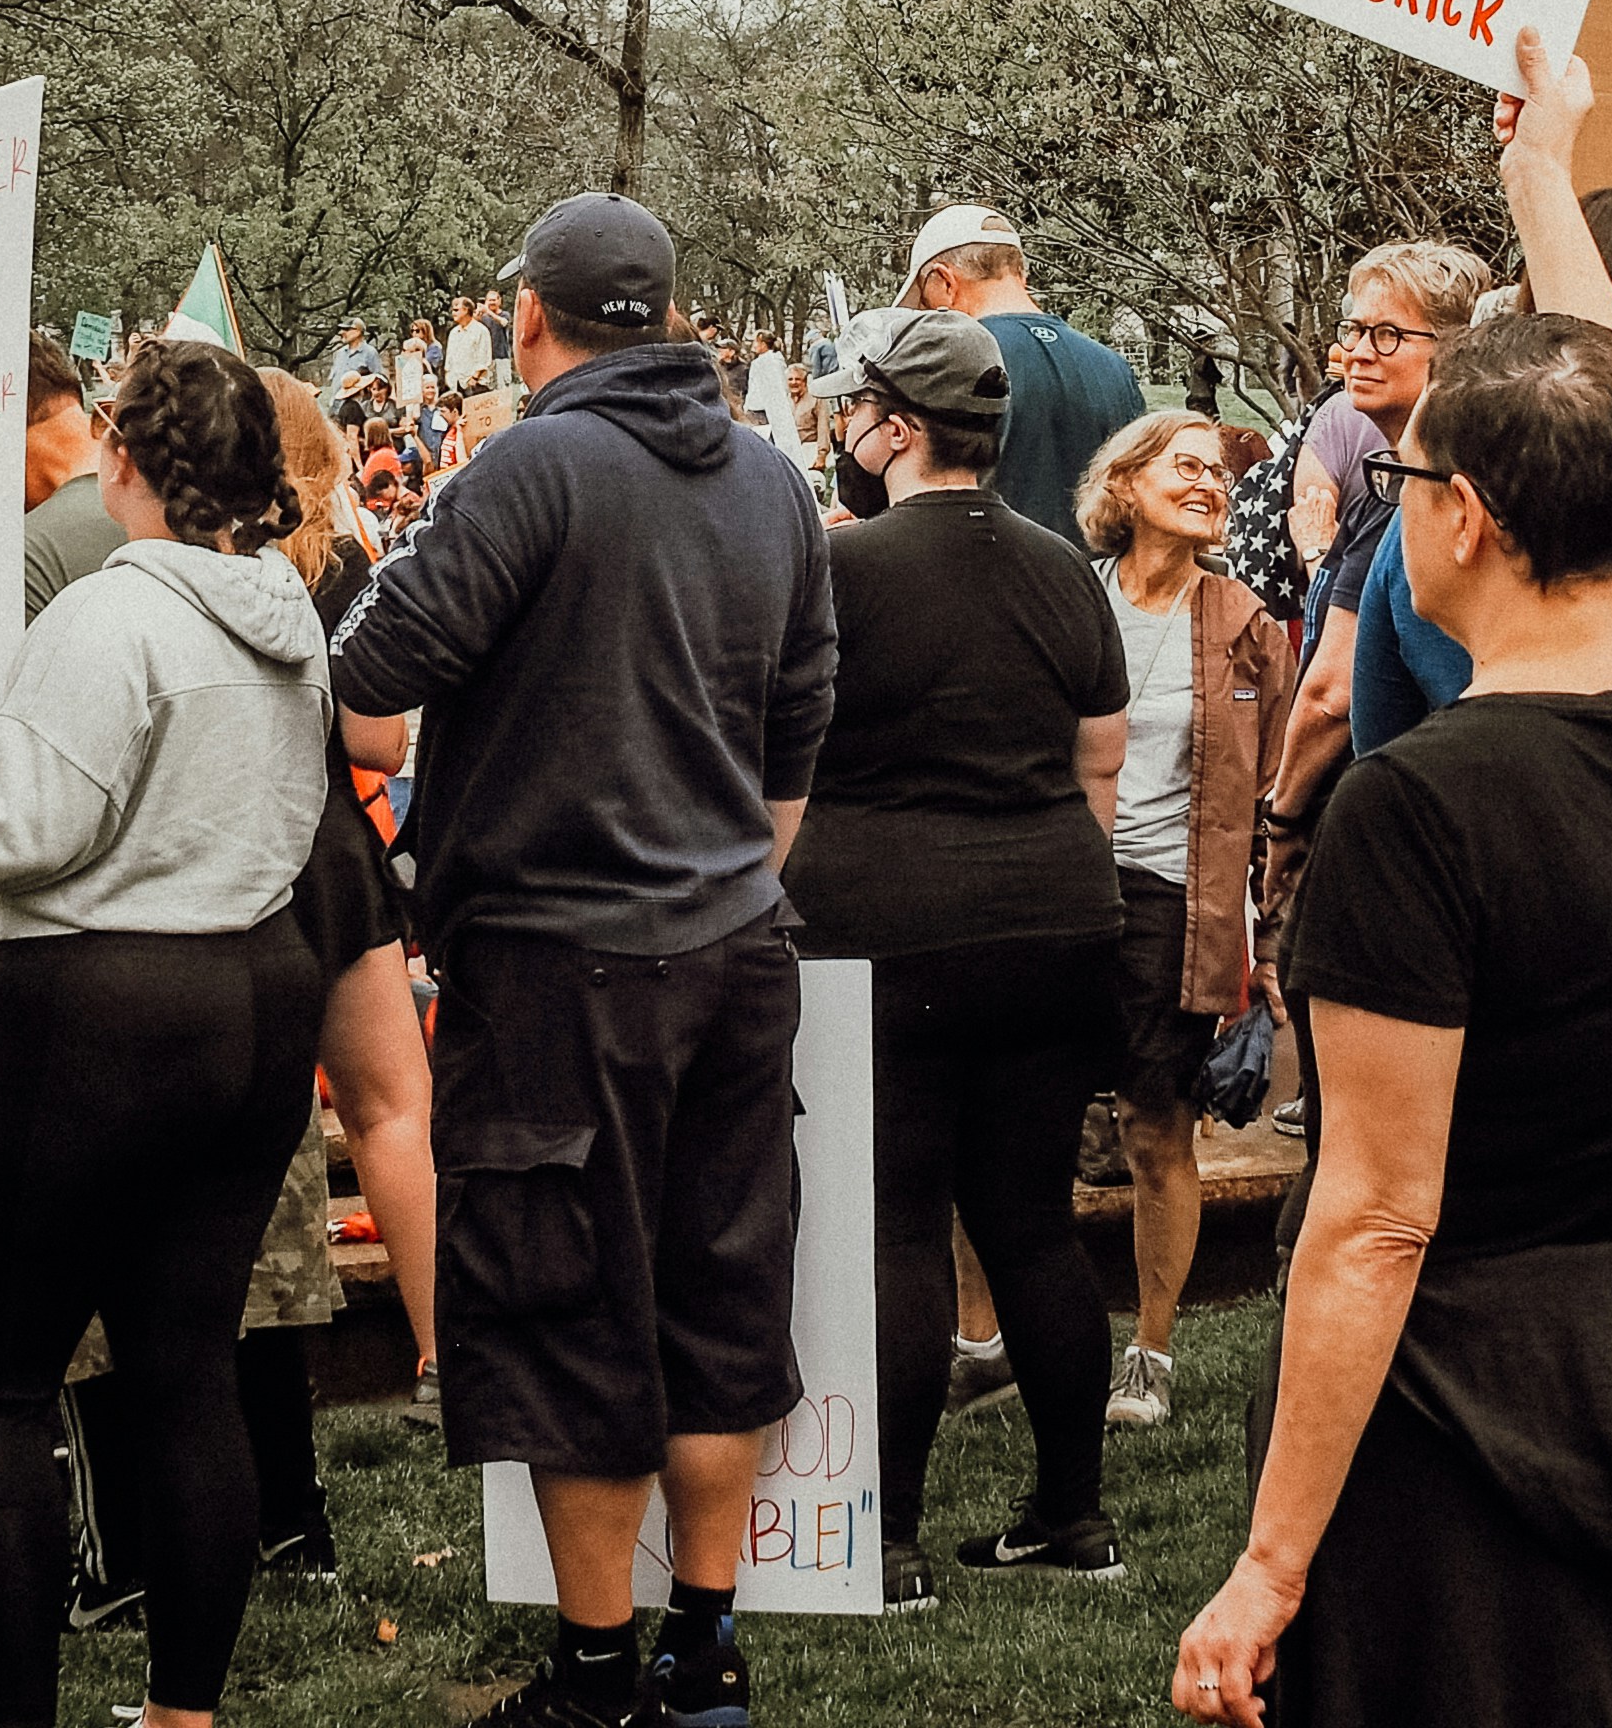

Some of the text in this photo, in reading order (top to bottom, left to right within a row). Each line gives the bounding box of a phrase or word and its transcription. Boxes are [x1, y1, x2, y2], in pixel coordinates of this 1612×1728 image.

[601, 300, 652, 318] NEW YORK
[757, 1393, 855, 1483] OD
